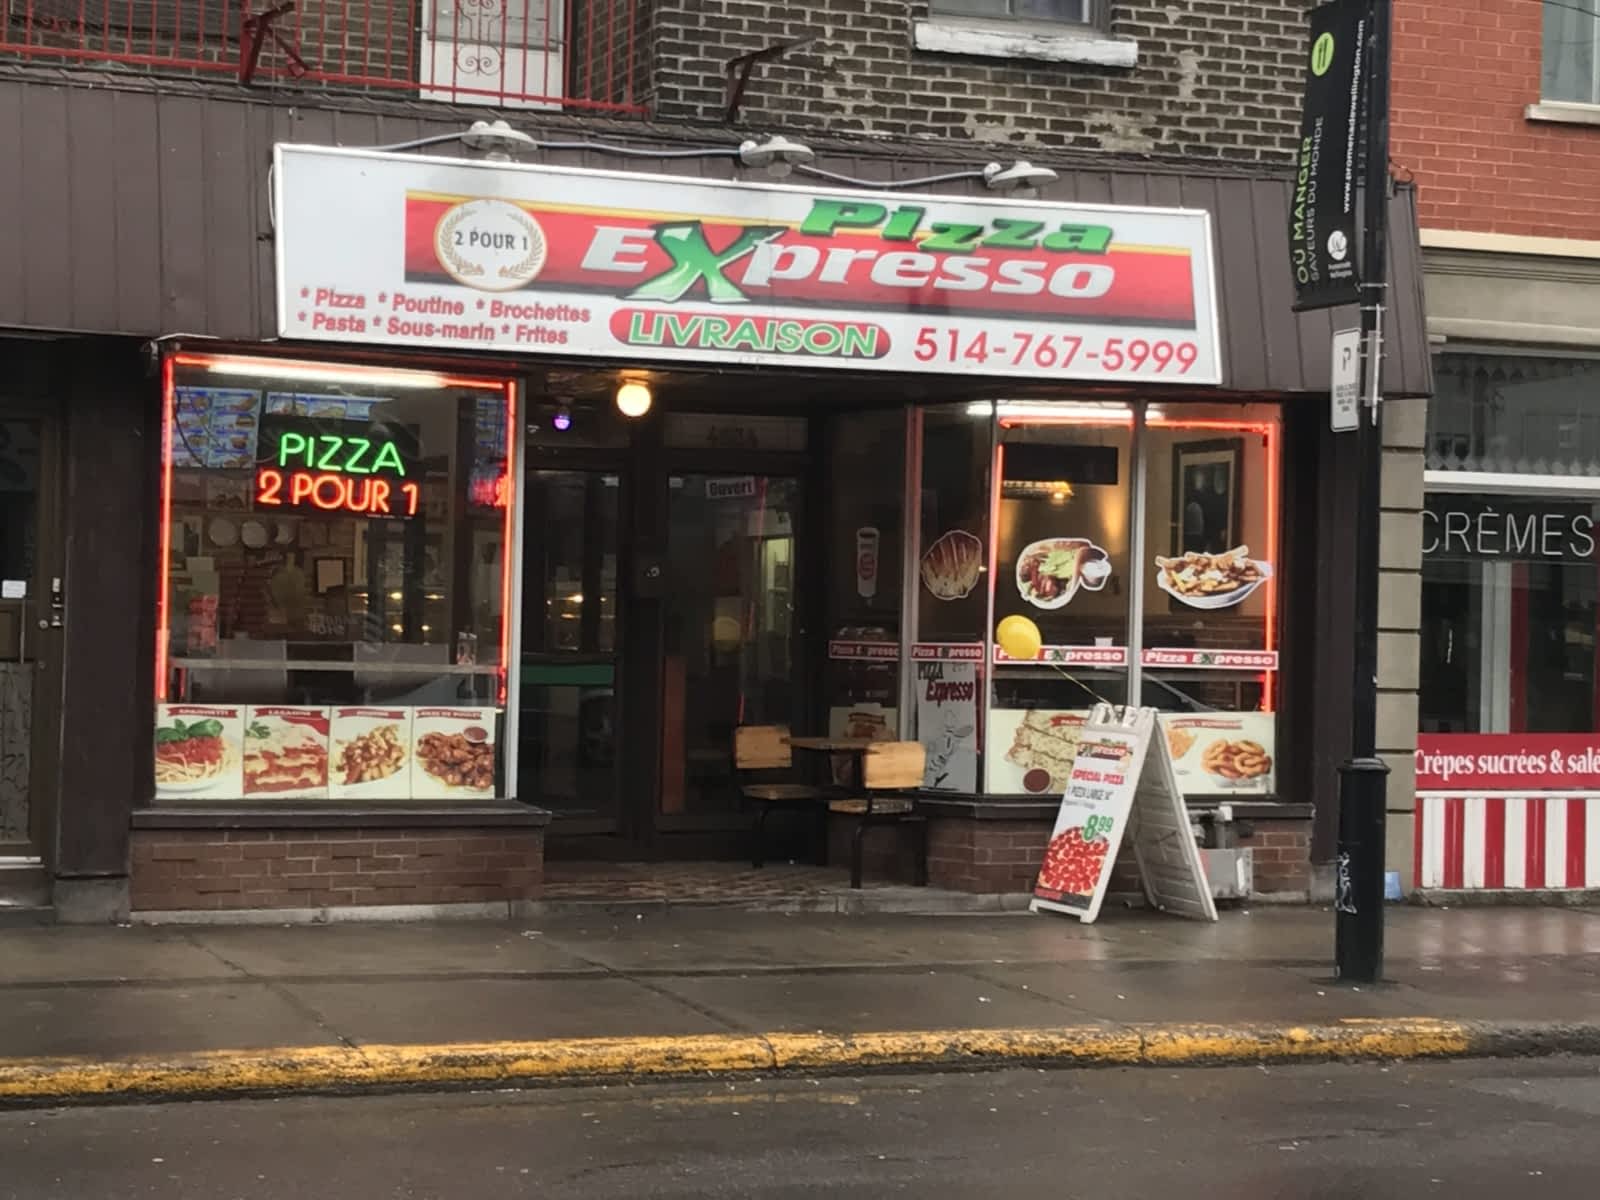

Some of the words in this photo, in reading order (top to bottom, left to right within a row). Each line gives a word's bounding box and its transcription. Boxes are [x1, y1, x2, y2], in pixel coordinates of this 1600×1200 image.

[1310, 115, 1324, 177] MONDE
[1307, 181, 1317, 204] DU
[454, 231, 464, 246] 2
[469, 231, 516, 251] POUR
[521, 235, 529, 251] 1
[800, 198, 1114, 255] Pizza
[314, 288, 367, 309] Pizza
[392, 294, 465, 316] Poutine
[489, 300, 591, 323] Brochettes
[312, 312, 367, 333] Pasta
[387, 316, 495, 340] Sous-marin
[515, 324, 568, 344] Frites
[628, 313, 878, 357] LIVRAISON
[913, 327, 1198, 375] 514-767-5999
[279, 432, 406, 477] PIZZA
[257, 469, 282, 505] 2
[290, 472, 391, 514] POUR
[402, 482, 419, 516] 1
[1422, 505, 1595, 557] CRÈMES
[1145, 651, 1188, 663] Pizza
[1477, 748, 1547, 775] sucrées
[1550, 748, 1564, 775] &
